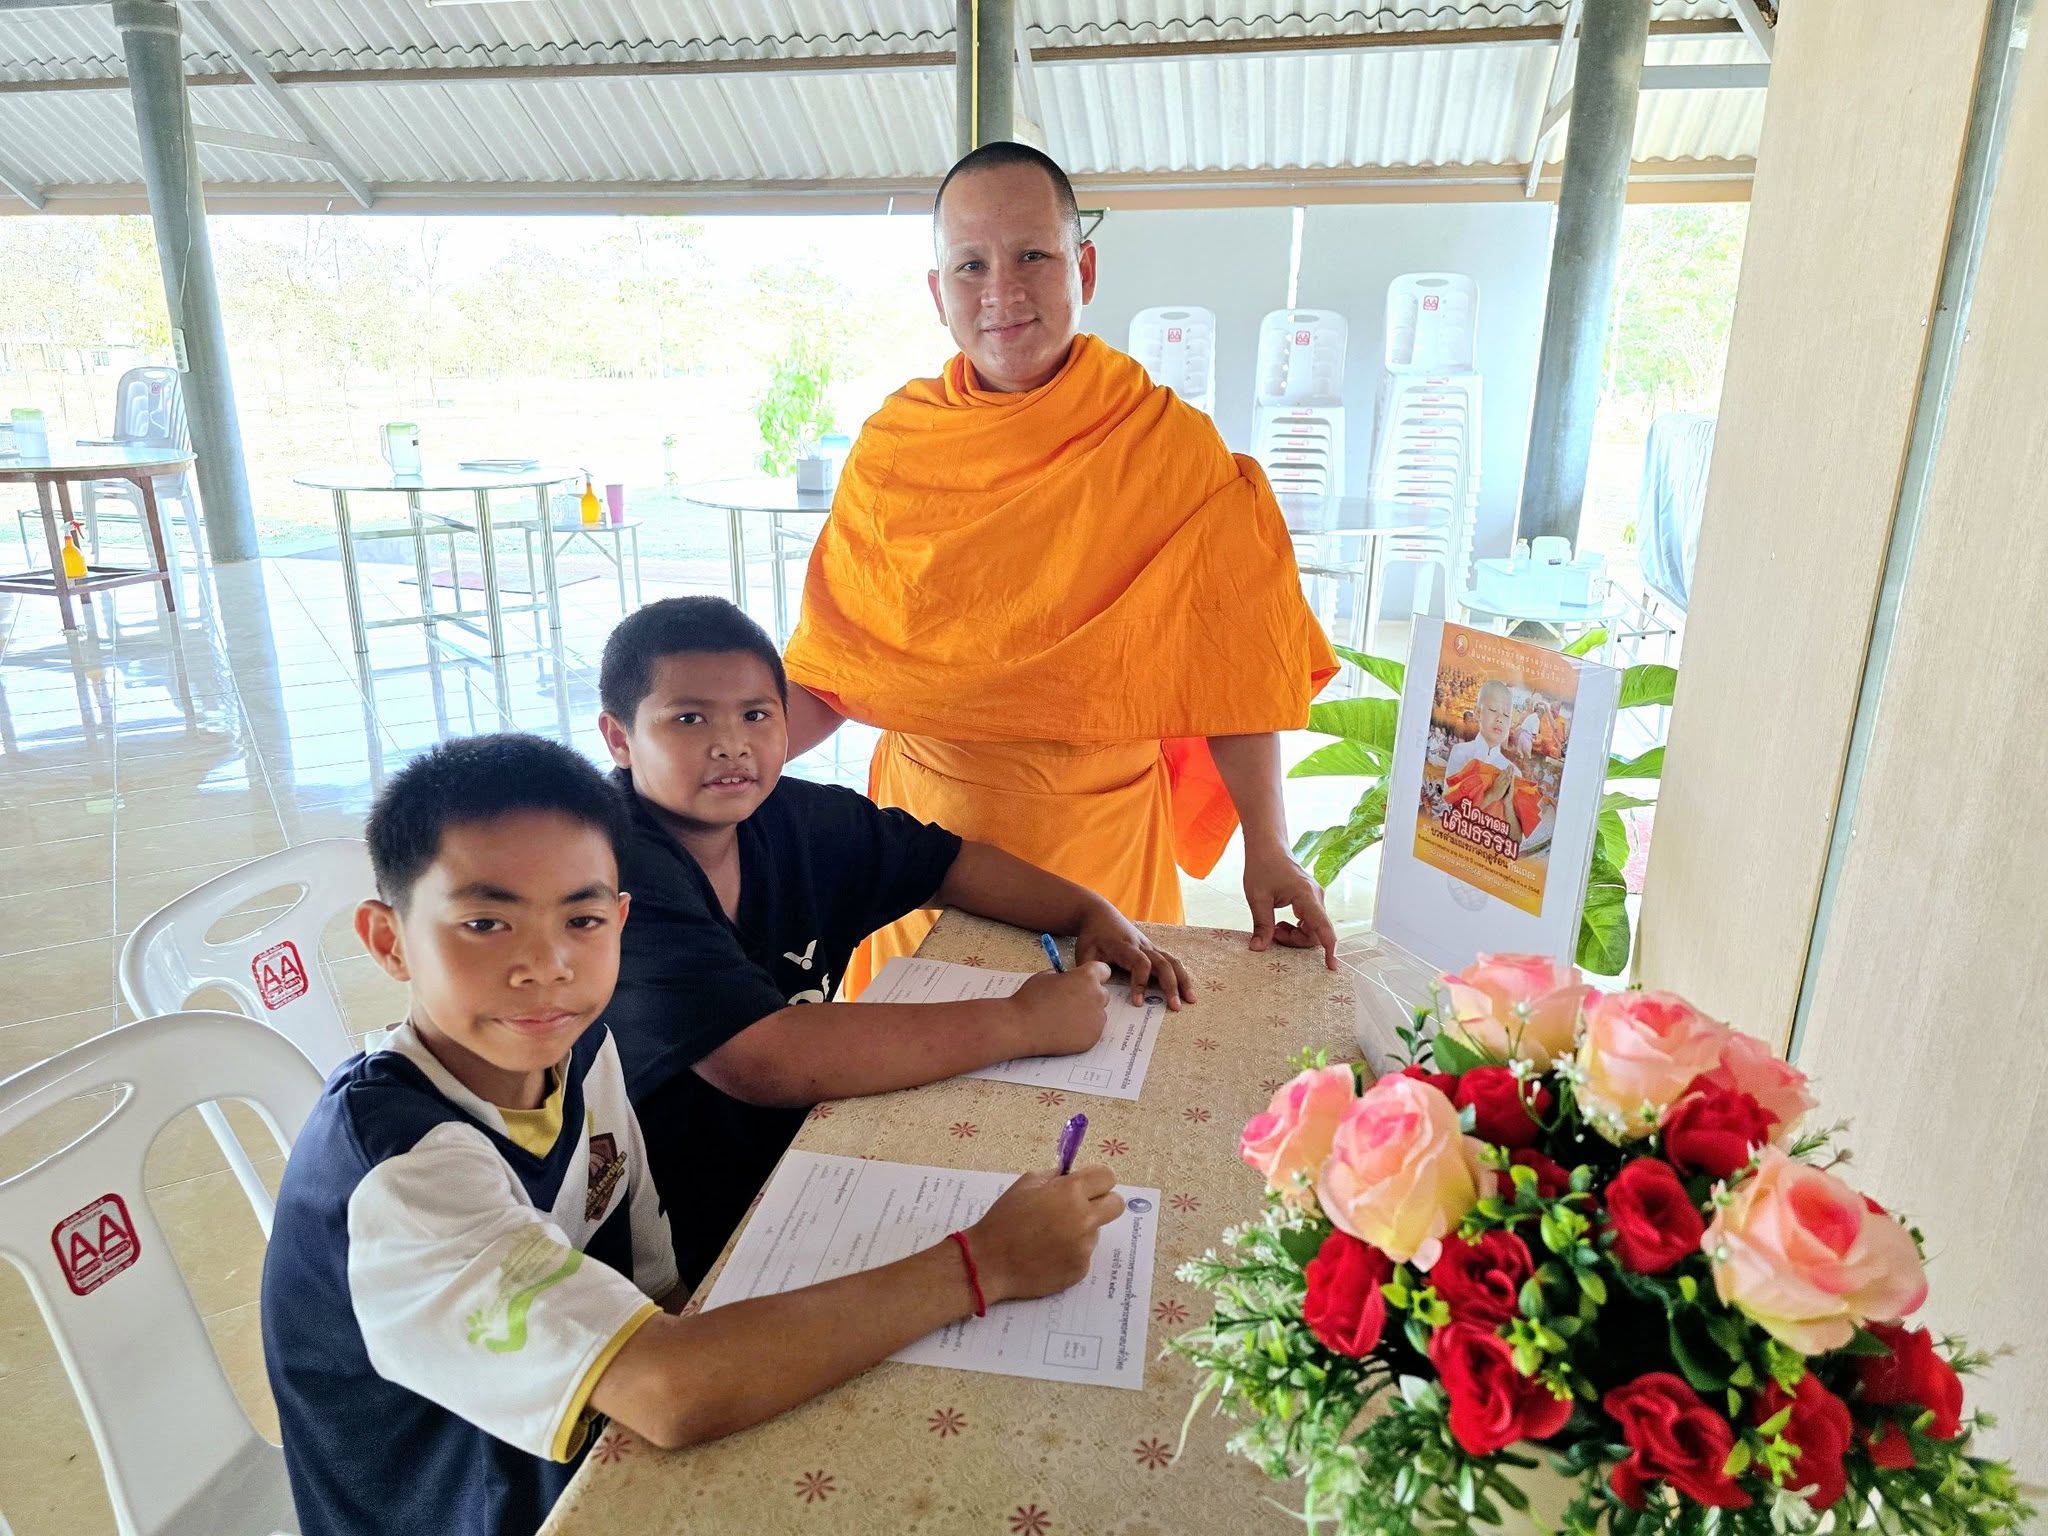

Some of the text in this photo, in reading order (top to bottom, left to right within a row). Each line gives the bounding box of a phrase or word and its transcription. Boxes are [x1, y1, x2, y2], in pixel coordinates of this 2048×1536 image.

[1442, 808, 1519, 860] เติมธรรม
[1460, 797, 1510, 837] ปิดเทอม
[263, 955, 300, 992] AA
[70, 1214, 129, 1272] AA
